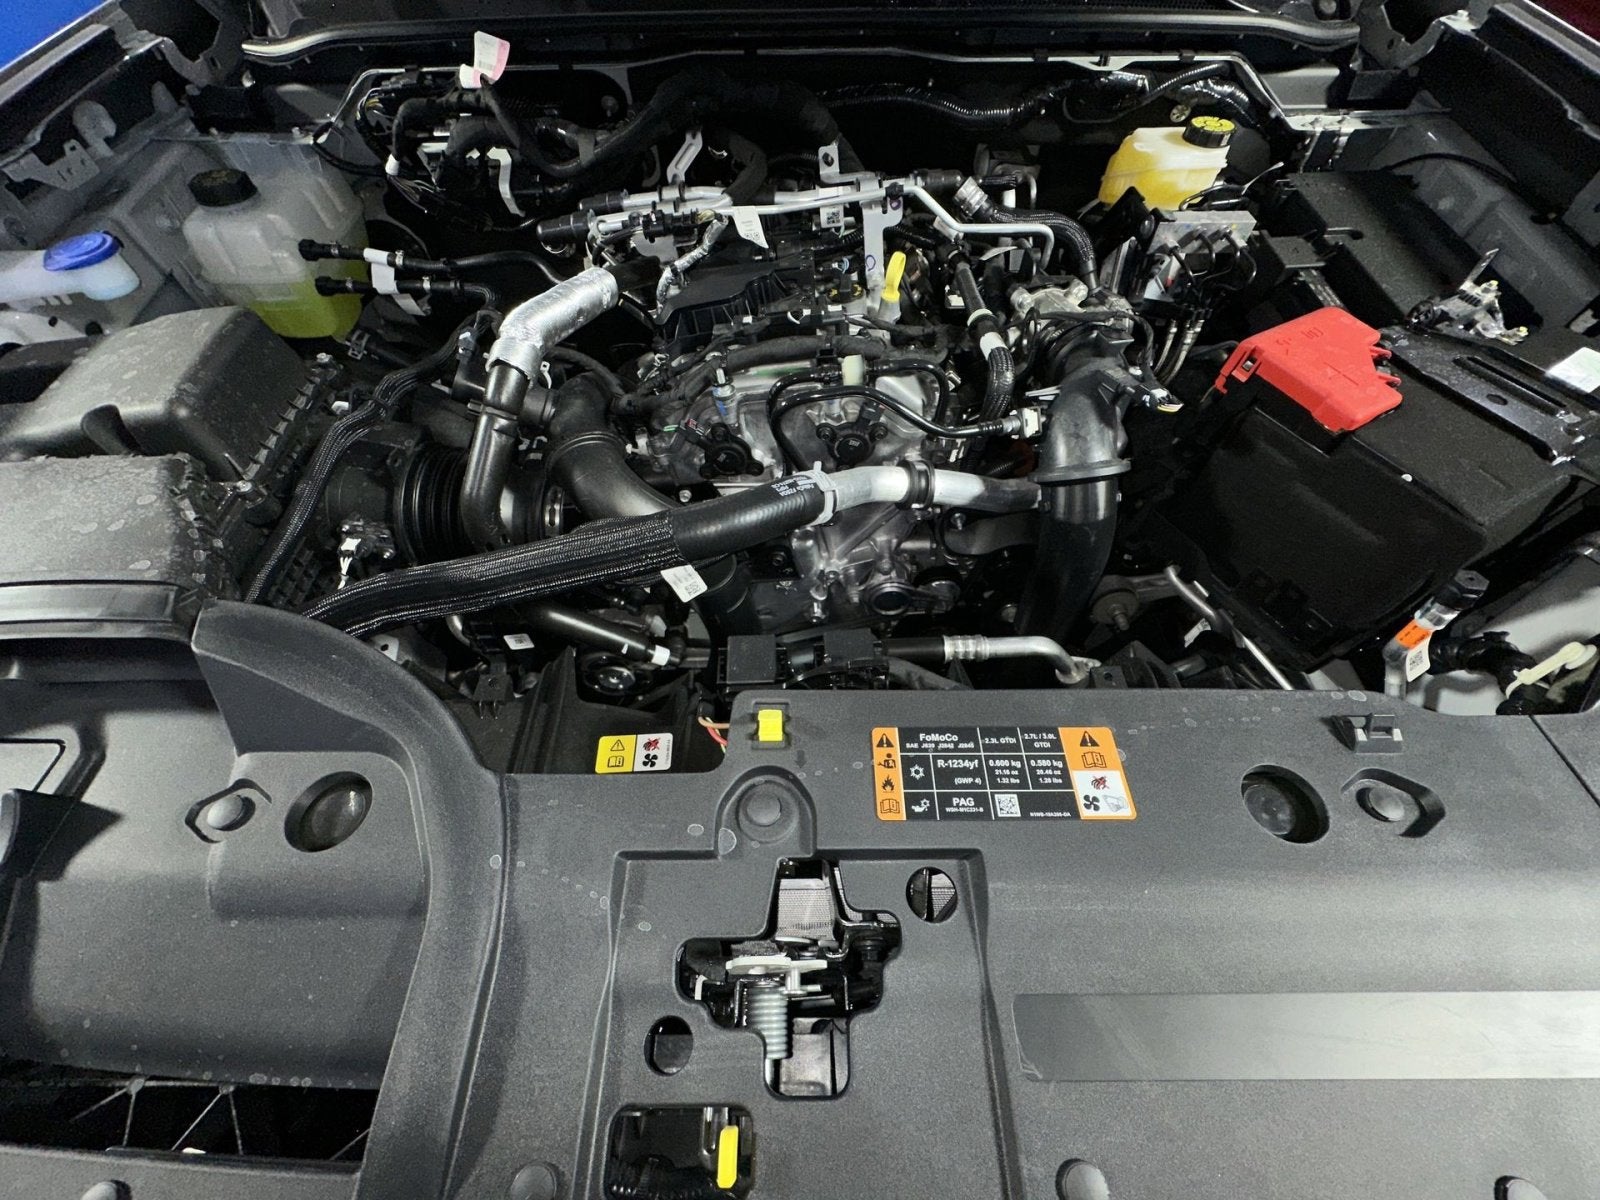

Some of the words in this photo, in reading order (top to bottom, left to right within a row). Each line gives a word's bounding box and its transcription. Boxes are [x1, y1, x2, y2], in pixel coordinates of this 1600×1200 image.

[919, 733, 959, 742] FoMoCo
[1000, 736, 1017, 744] GTDI
[937, 759, 979, 770] R-1234yf
[988, 759, 1009, 767] 0.600
[1010, 759, 1021, 768] kg
[1052, 759, 1063, 768] kg
[954, 777, 974, 785] (GWP
[952, 797, 975, 807] PAG
